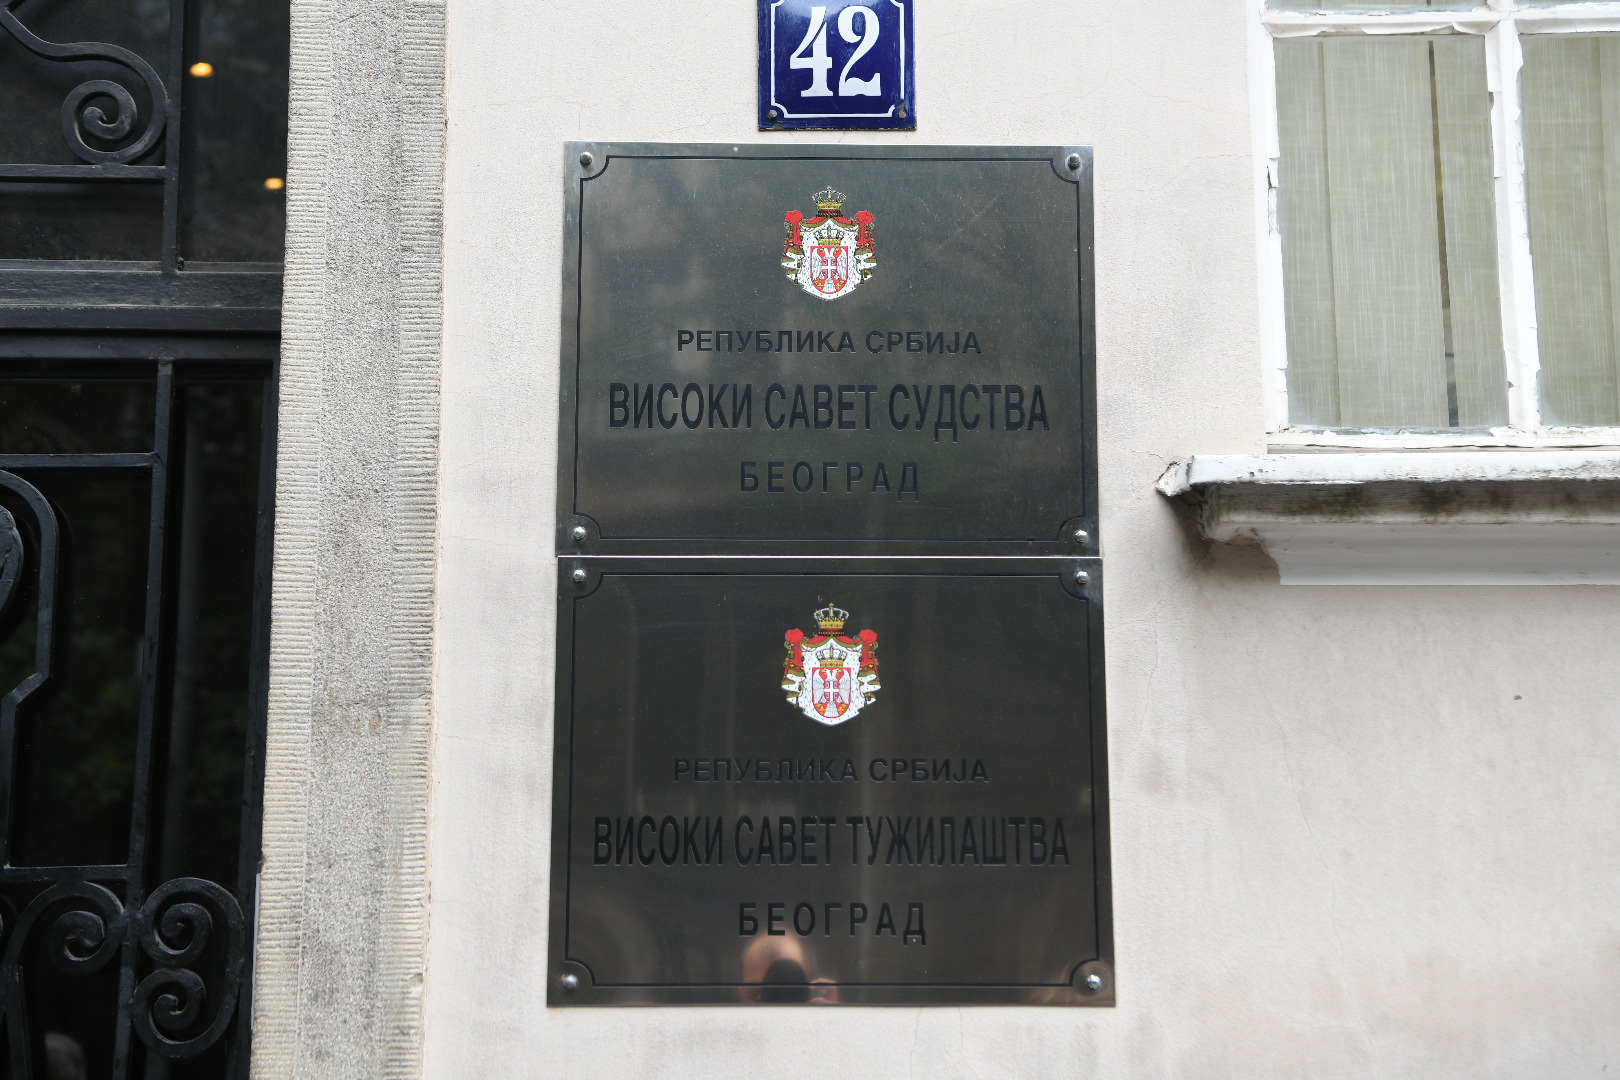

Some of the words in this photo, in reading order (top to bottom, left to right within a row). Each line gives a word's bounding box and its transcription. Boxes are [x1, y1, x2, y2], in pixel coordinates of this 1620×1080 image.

[790, 5, 881, 97] 42
[677, 329, 857, 353] РЕПУБЛИКА
[865, 330, 982, 354] СРБИЈА
[609, 382, 752, 430] ВИСОКИ
[764, 383, 877, 431] САВЕТ
[888, 384, 1050, 443] СУДСТВА
[740, 461, 919, 502] БЕОГРАД
[674, 758, 859, 783] РЕПУБЛИКА
[868, 758, 989, 784] СРБИЈА
[593, 815, 724, 867] ВИСОКИ
[734, 815, 837, 867] САВЕТ
[846, 816, 1070, 867] ТУЖИЛАШТВА
[738, 902, 926, 945] БЕОГРАД
